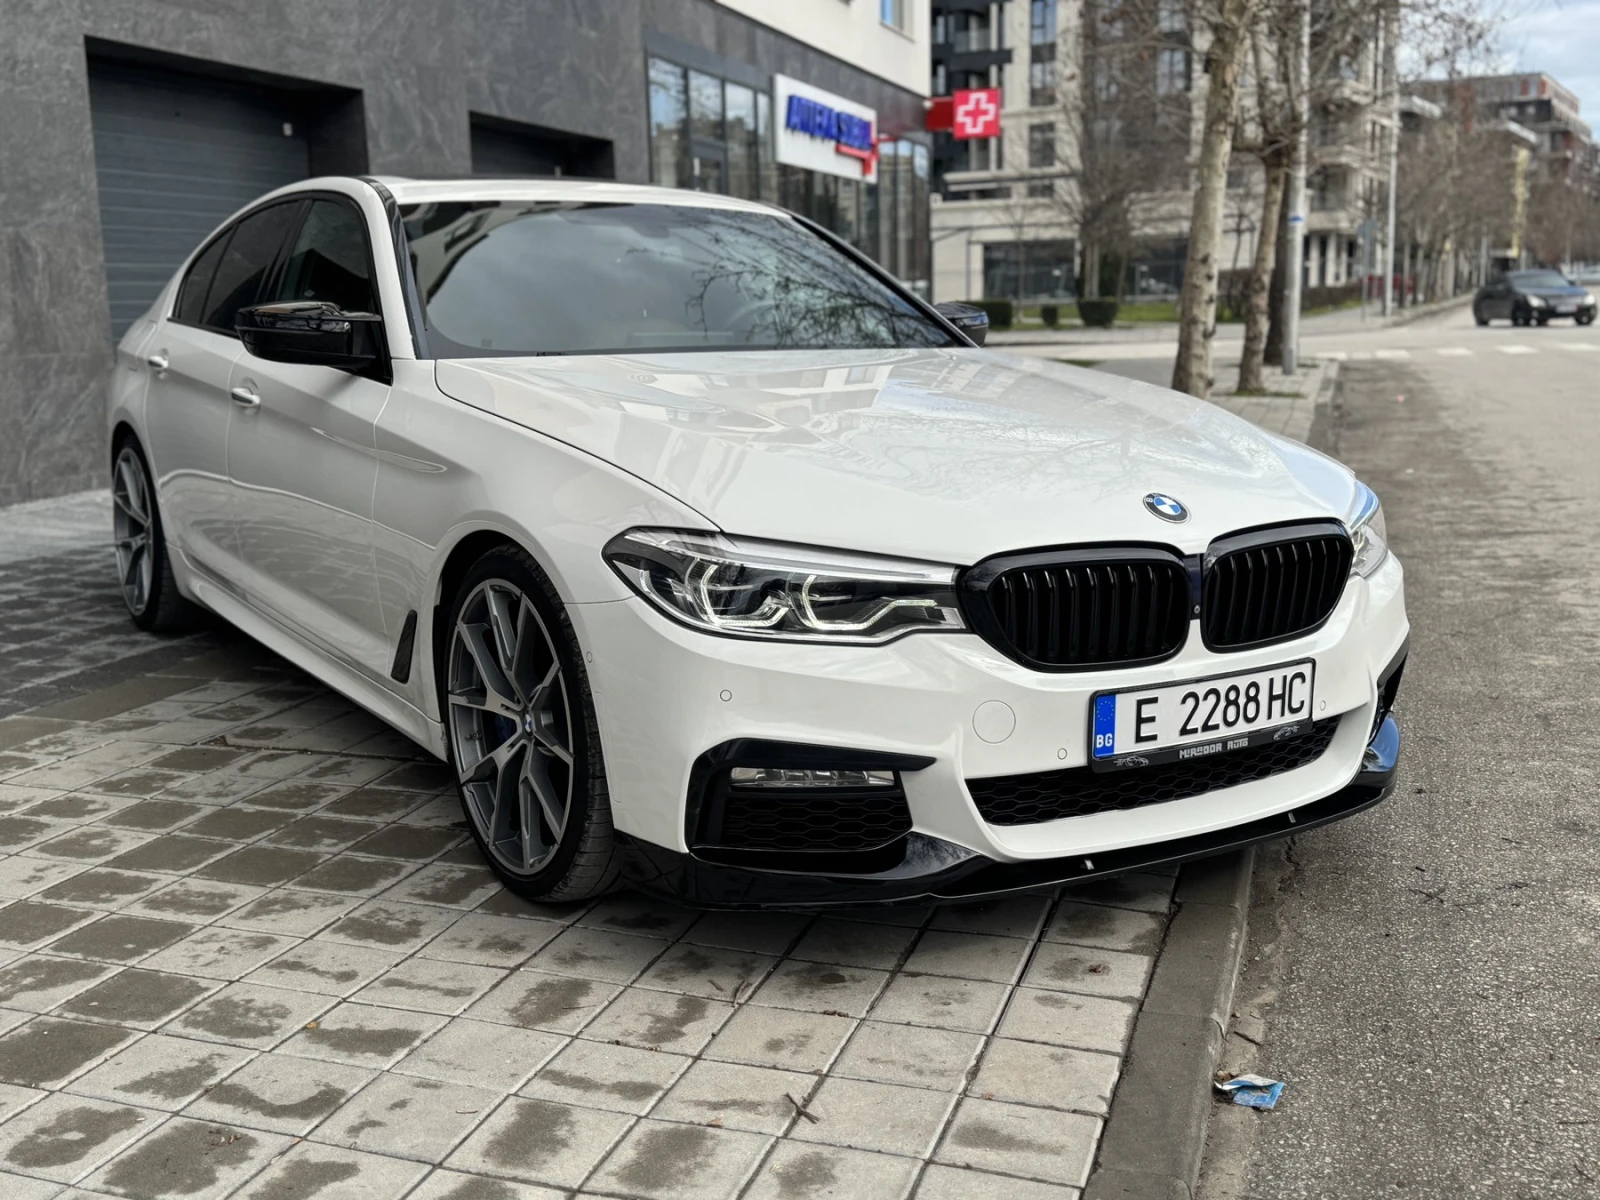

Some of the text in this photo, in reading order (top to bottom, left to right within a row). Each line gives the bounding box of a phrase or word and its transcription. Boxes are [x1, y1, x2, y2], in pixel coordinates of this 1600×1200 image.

[1135, 671, 1306, 744] E 2288 HC
[1096, 733, 1113, 748] BG
